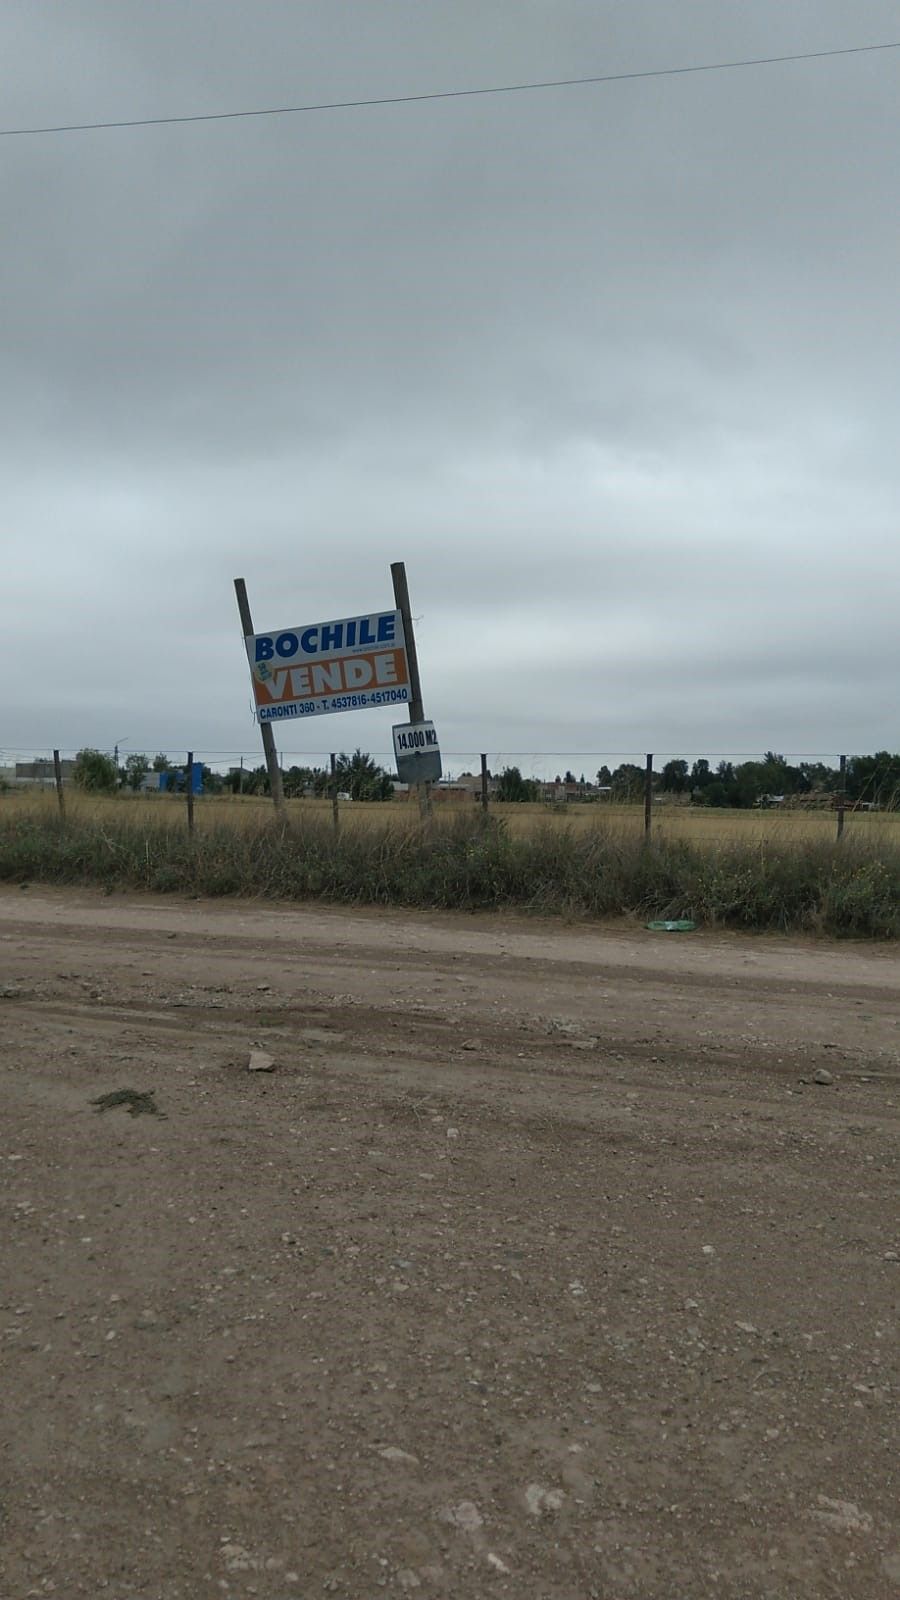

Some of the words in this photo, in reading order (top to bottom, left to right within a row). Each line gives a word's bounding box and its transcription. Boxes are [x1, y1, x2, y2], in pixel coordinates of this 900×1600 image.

[255, 614, 396, 662] BOCHILE
[265, 653, 397, 699] VENDE
[260, 703, 298, 720] CARONTI
[299, 702, 315, 715] 360
[321, 700, 330, 711] T.
[397, 731, 425, 750] 14.000
[425, 729, 438, 746] M2
